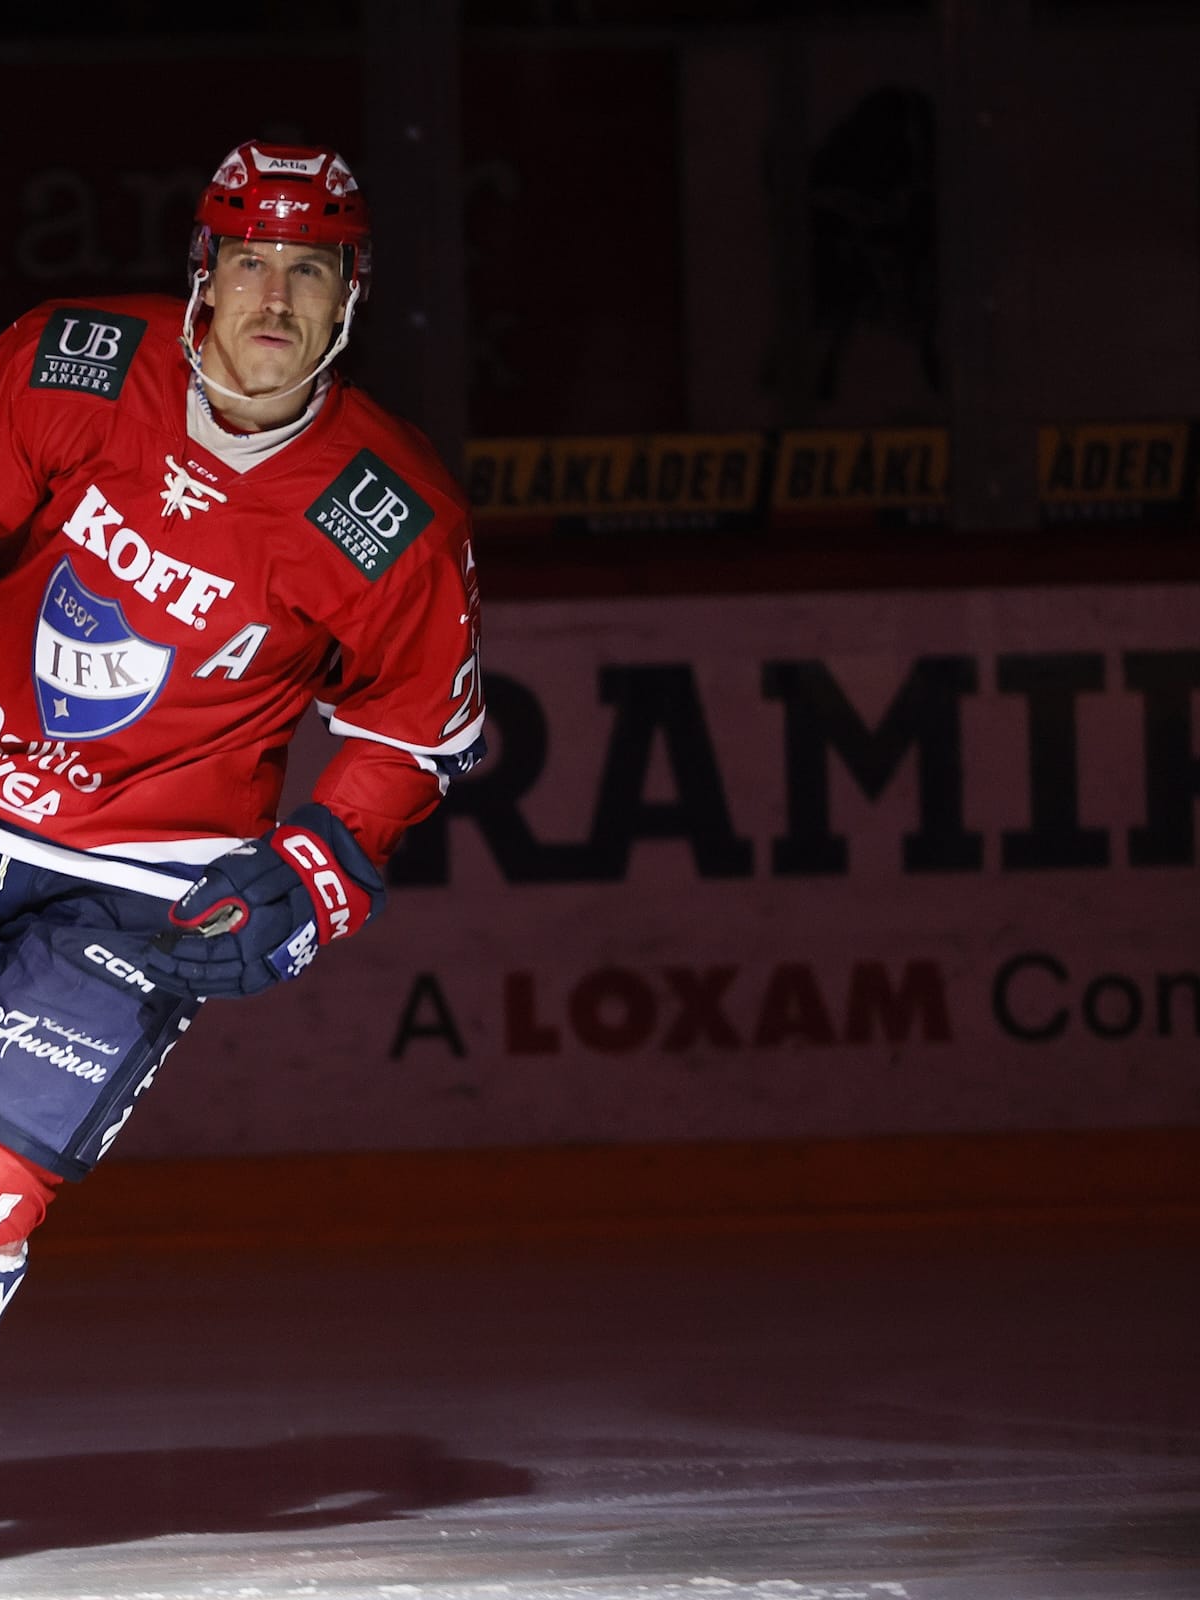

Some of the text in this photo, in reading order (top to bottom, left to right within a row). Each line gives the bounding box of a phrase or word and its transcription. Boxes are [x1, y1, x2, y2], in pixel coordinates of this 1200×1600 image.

[269, 159, 307, 171] Aktia
[59, 319, 122, 361] UB
[40, 371, 111, 392] BANKERS
[49, 361, 108, 379] UNITED
[187, 460, 218, 482] CCM
[349, 468, 409, 539] UB
[62, 483, 235, 627] KOFF
[316, 512, 376, 570] BANKERS
[330, 507, 379, 556] UNITED
[54, 584, 99, 638] 1897
[192, 622, 271, 681] A
[283, 834, 350, 939] CCM
[83, 943, 156, 993] CCM
[391, 972, 465, 1058] A
[504, 959, 954, 1057] LOXAM
